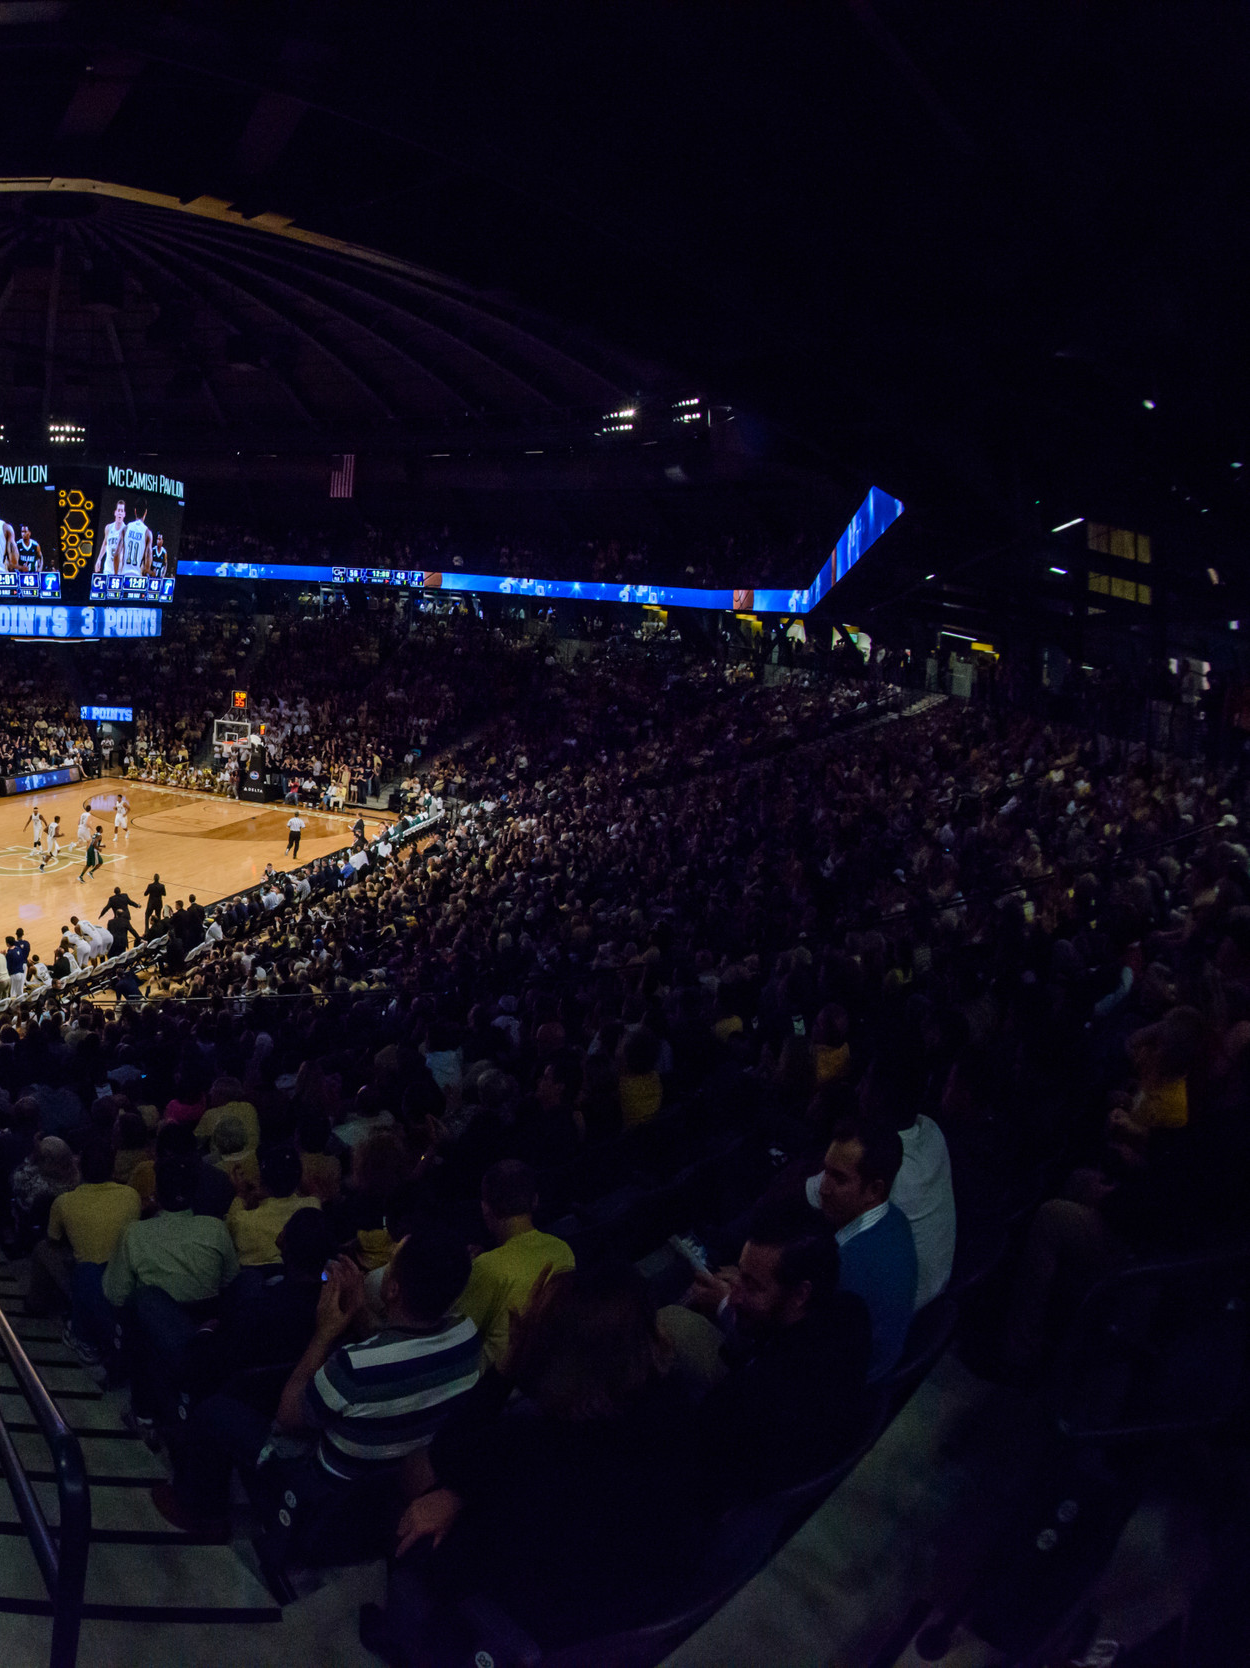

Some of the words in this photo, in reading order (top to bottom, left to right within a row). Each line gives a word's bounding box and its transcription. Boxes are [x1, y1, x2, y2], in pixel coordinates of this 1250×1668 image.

[126, 540, 140, 567] 11
[23, 575, 35, 587] 43
[45, 576, 57, 591] T
[111, 577, 120, 589] 56
[129, 576, 146, 589] 12:01
[150, 580, 159, 591] 43
[81, 606, 95, 636] 3
[104, 607, 157, 637] POINTS
[234, 698, 245, 707] 35
[91, 707, 133, 722] POINTS
